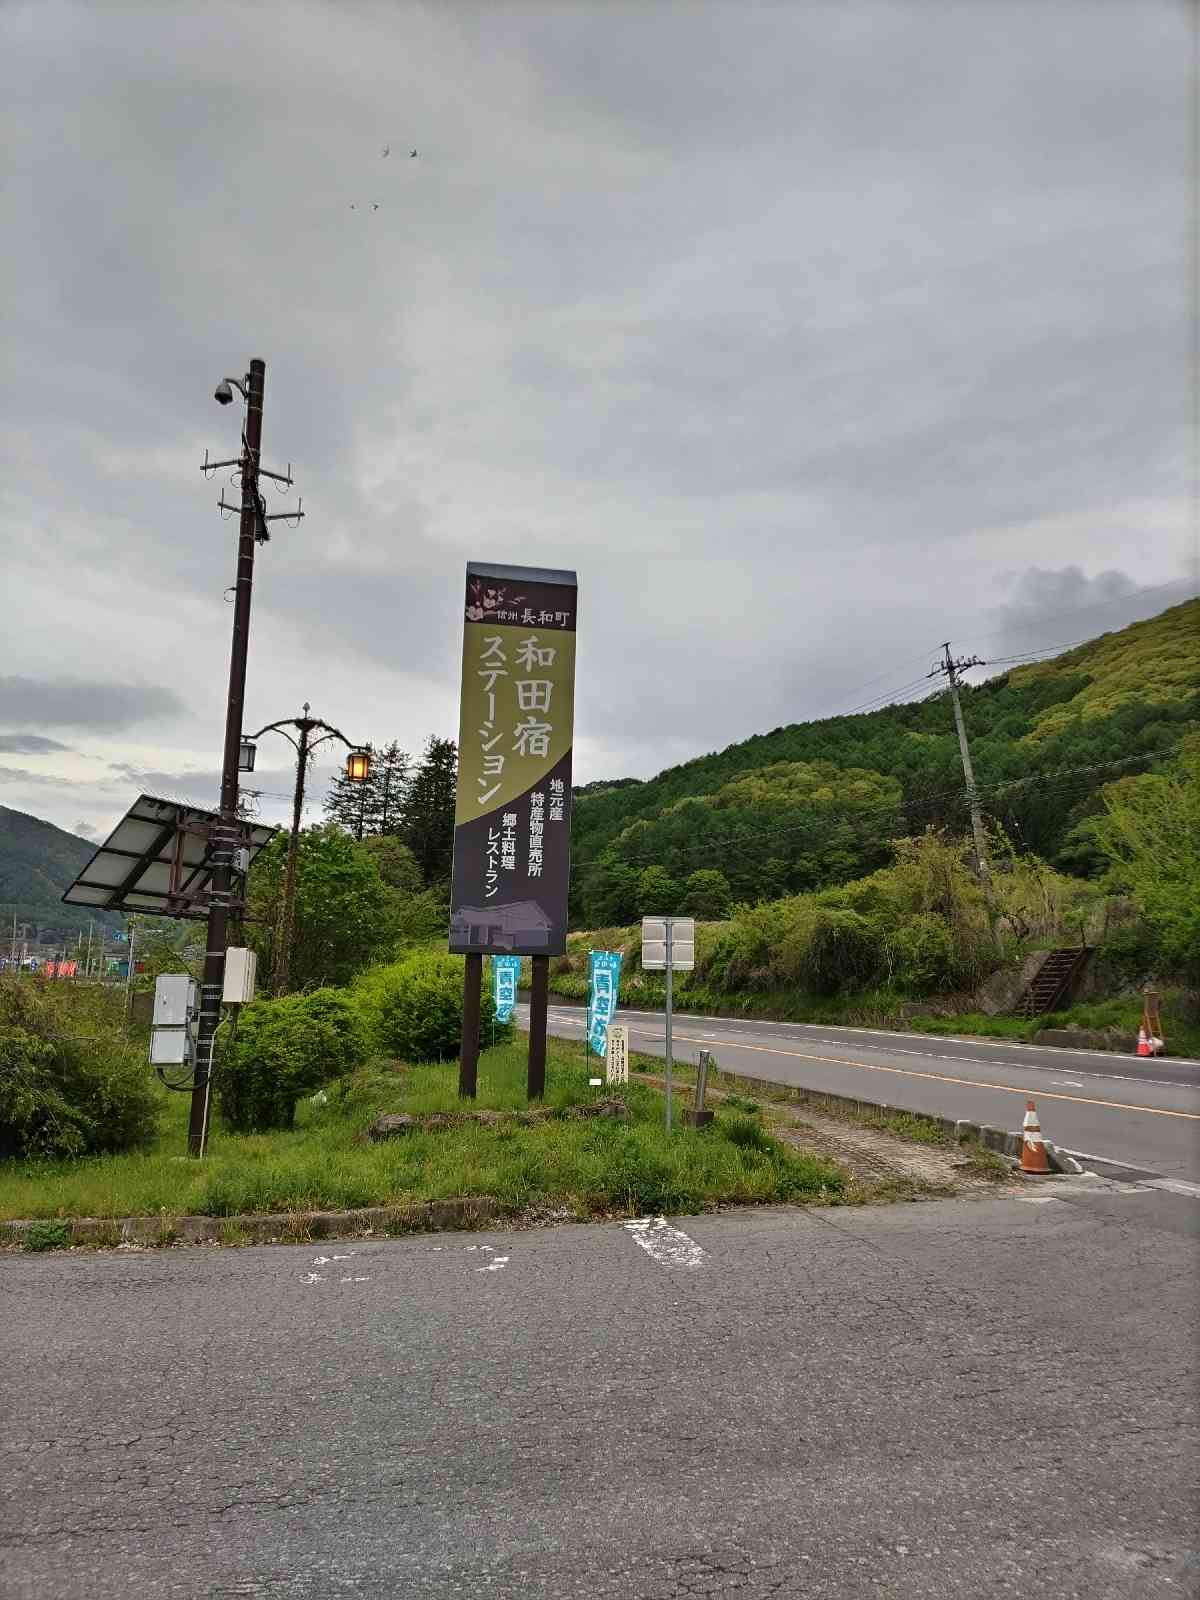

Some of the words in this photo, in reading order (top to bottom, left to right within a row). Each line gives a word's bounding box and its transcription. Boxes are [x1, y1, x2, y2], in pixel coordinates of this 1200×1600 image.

[521, 607, 570, 627] 長和町
[512, 635, 557, 759] 和田宿
[549, 778, 565, 821] 地元産
[485, 827, 501, 898] レストラン
[500, 812, 518, 870] 郷土料理
[527, 791, 545, 877] 特産物直売所
